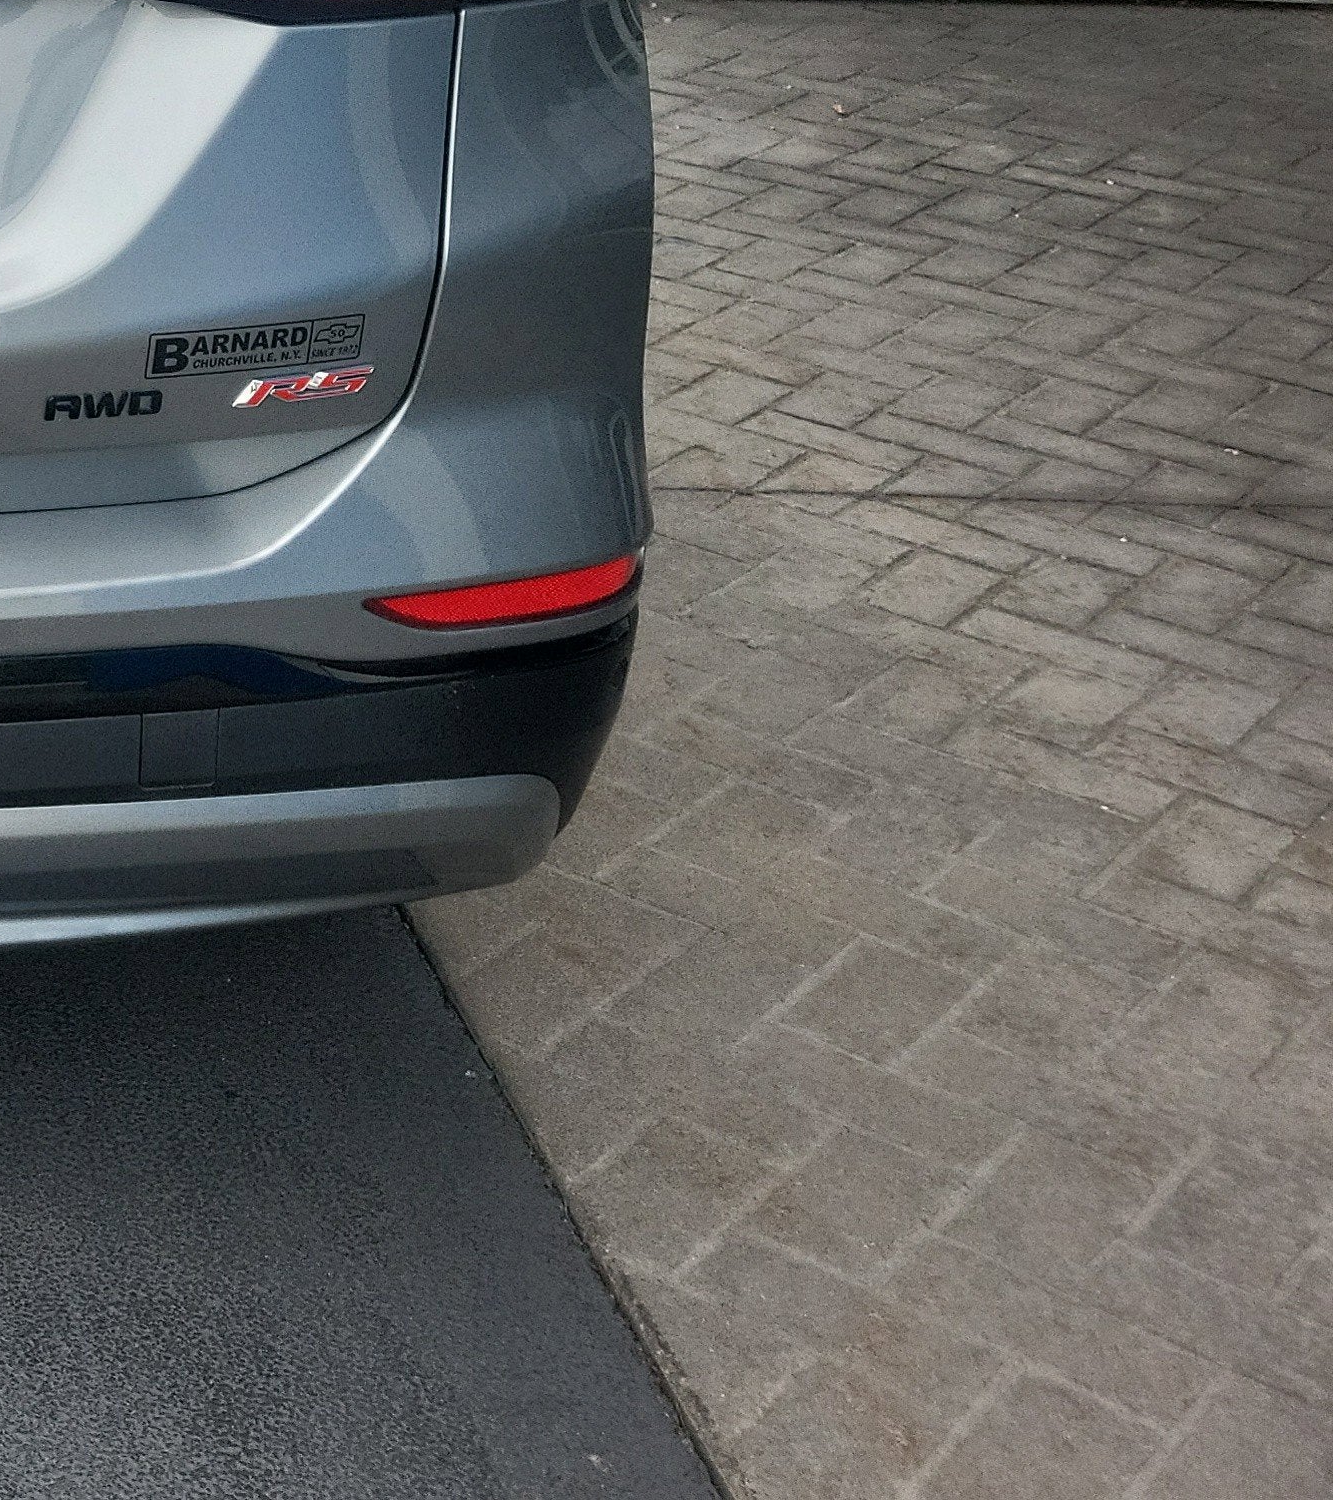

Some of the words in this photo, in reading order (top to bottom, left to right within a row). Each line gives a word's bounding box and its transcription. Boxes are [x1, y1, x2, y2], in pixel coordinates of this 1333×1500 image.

[151, 325, 308, 375] BARNARD
[280, 350, 301, 360] N.Y.
[44, 389, 163, 421] AWD
[232, 366, 375, 408] RS
